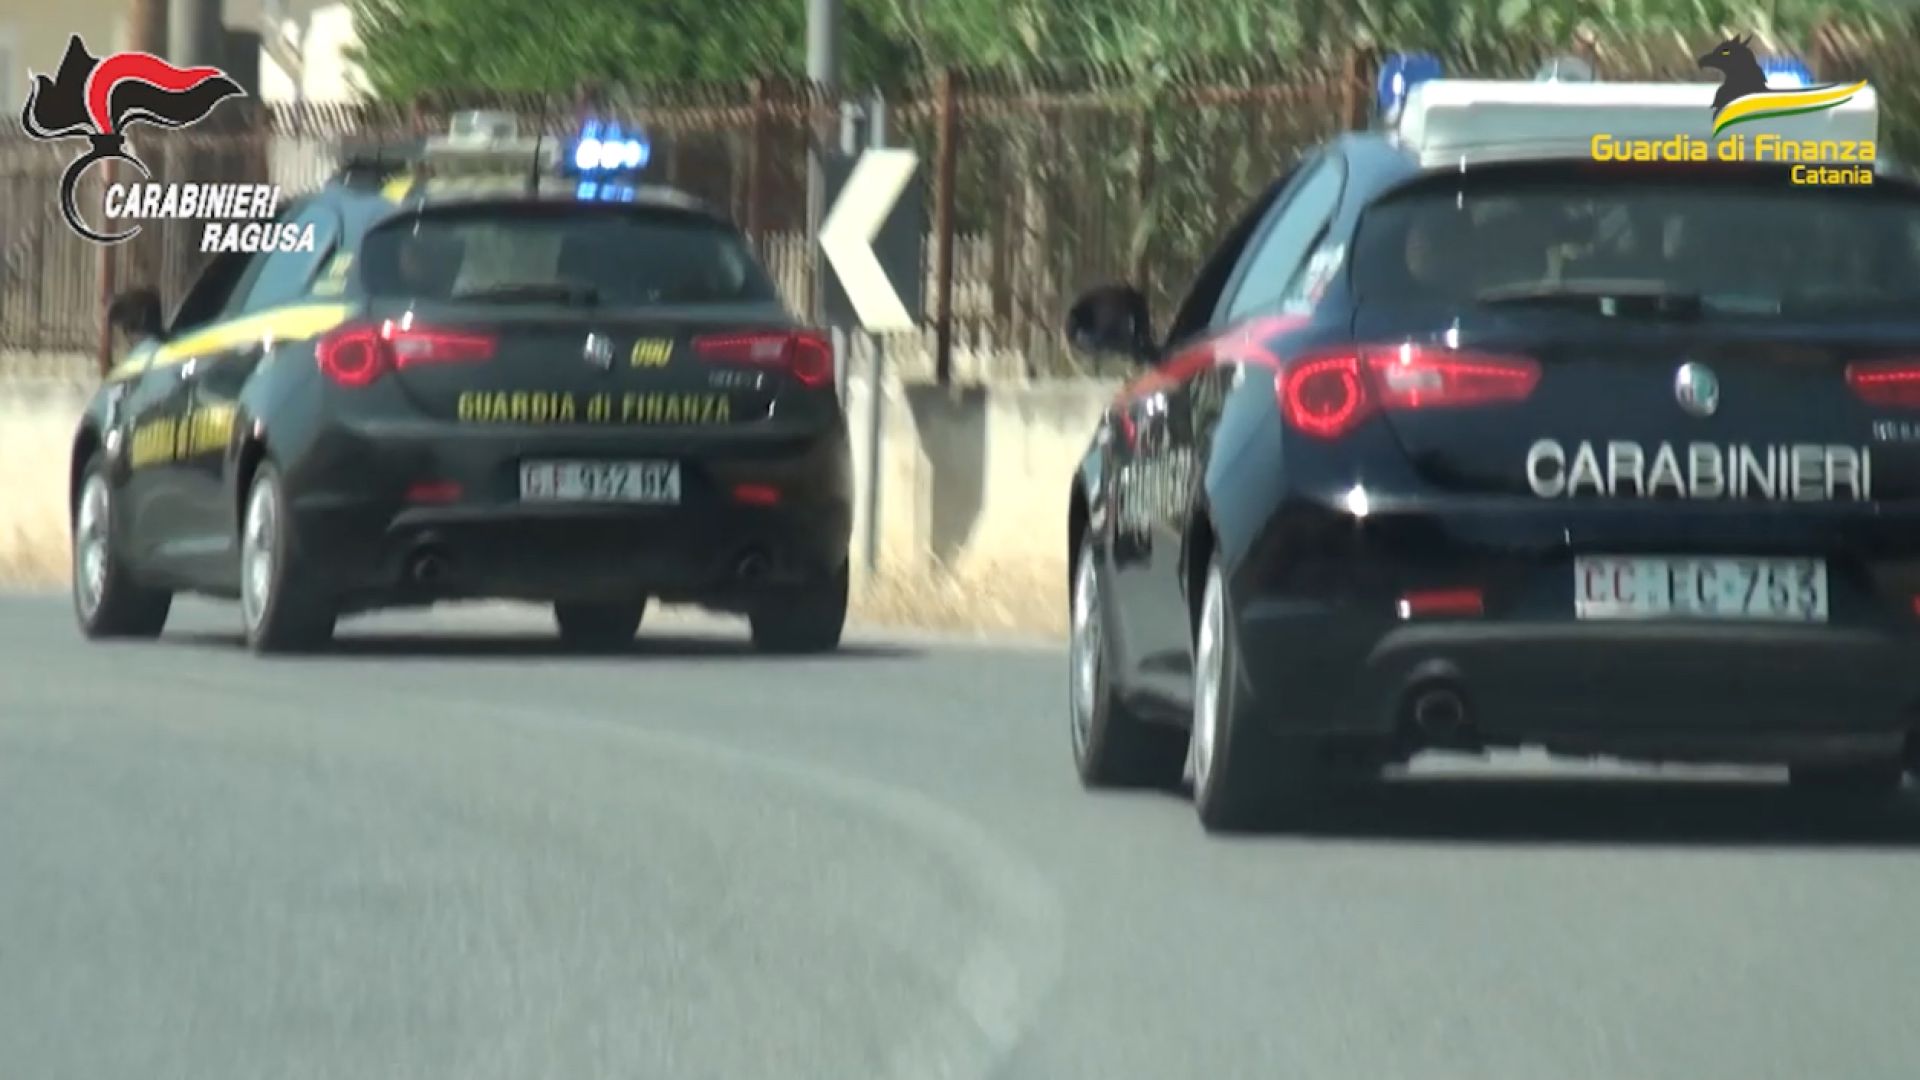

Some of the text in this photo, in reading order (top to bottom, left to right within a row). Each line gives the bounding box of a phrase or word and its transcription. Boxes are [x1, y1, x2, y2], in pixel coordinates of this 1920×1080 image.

[457, 391, 731, 424] GUARDIA di FINANZA
[1526, 438, 1872, 501] CARABINIERI
